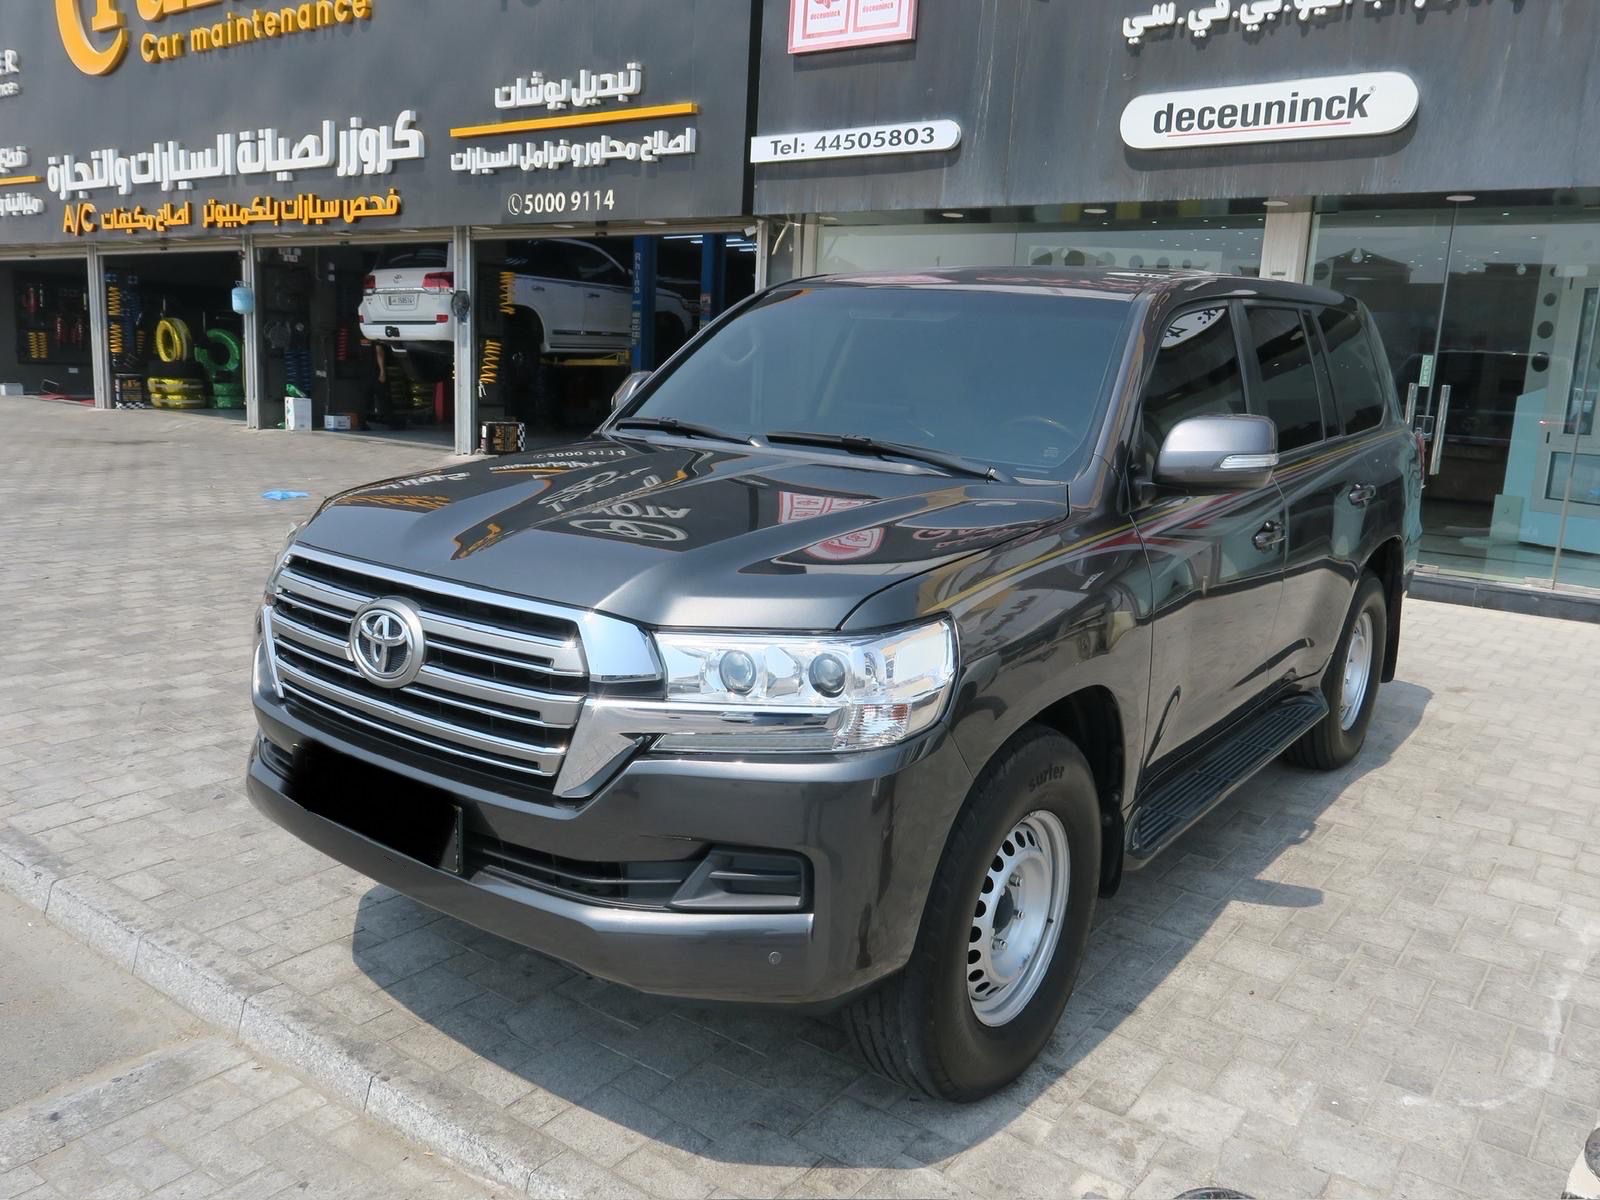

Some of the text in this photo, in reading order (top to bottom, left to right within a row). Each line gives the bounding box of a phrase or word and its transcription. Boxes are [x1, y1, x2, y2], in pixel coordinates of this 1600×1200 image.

[140, 33, 183, 63] Car
[191, 0, 373, 52] maintenance
[494, 62, 642, 110] تبديل بوشات
[1153, 86, 1369, 134] deceuninck
[237, 120, 336, 182] لصيانة
[337, 110, 425, 177] كروزر
[584, 135, 640, 166] محاور
[640, 127, 697, 162] اصلاح
[770, 126, 935, 156] Tel: 44505803
[47, 148, 132, 200] والتجارة
[130, 133, 237, 192] السيارات
[450, 143, 522, 175] السيارات
[101, 201, 192, 234] اصلاح مكيفات
[281, 193, 341, 225] سيارات
[343, 188, 402, 224] فحص
[524, 189, 615, 215] 5000 9114
[62, 203, 97, 237] A/C
